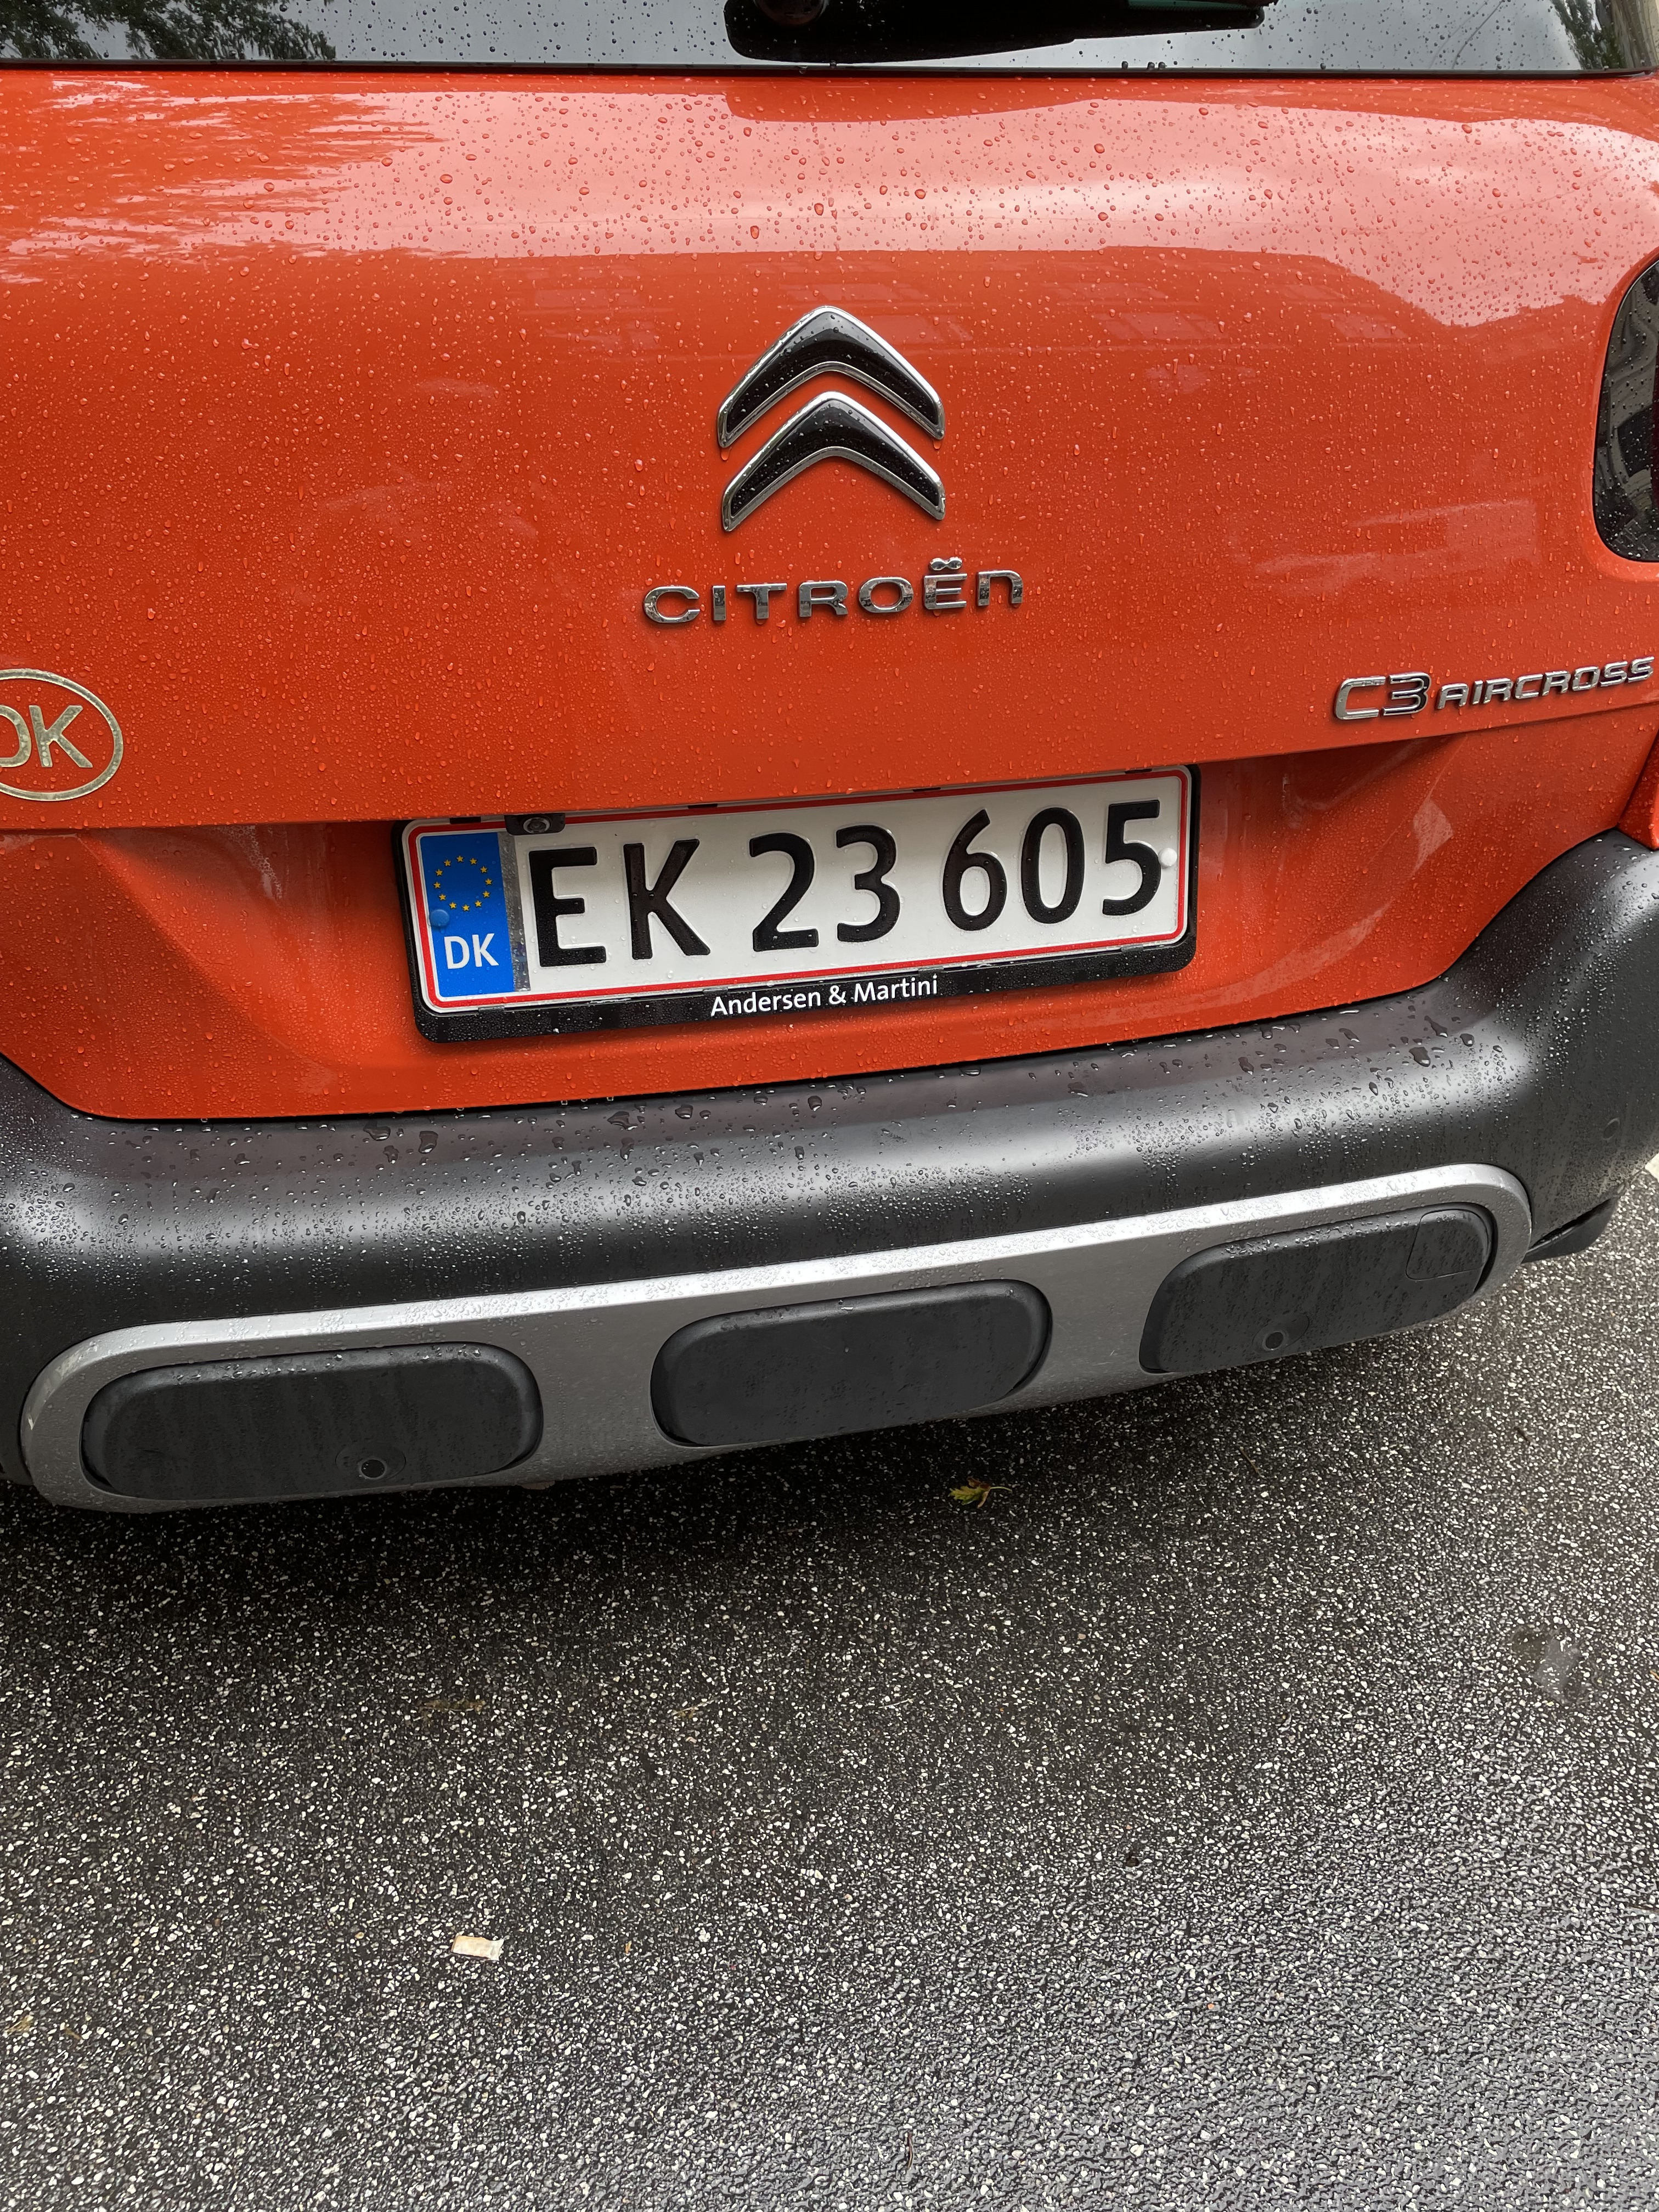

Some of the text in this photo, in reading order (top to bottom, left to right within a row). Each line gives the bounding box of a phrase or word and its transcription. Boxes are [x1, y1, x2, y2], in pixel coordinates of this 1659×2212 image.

[1335, 656, 1655, 720] C3 AIRCROSS
[528, 798, 1163, 967] EK 23 605
[443, 933, 500, 969] DK
[710, 973, 938, 1017] Andersen & Martini
